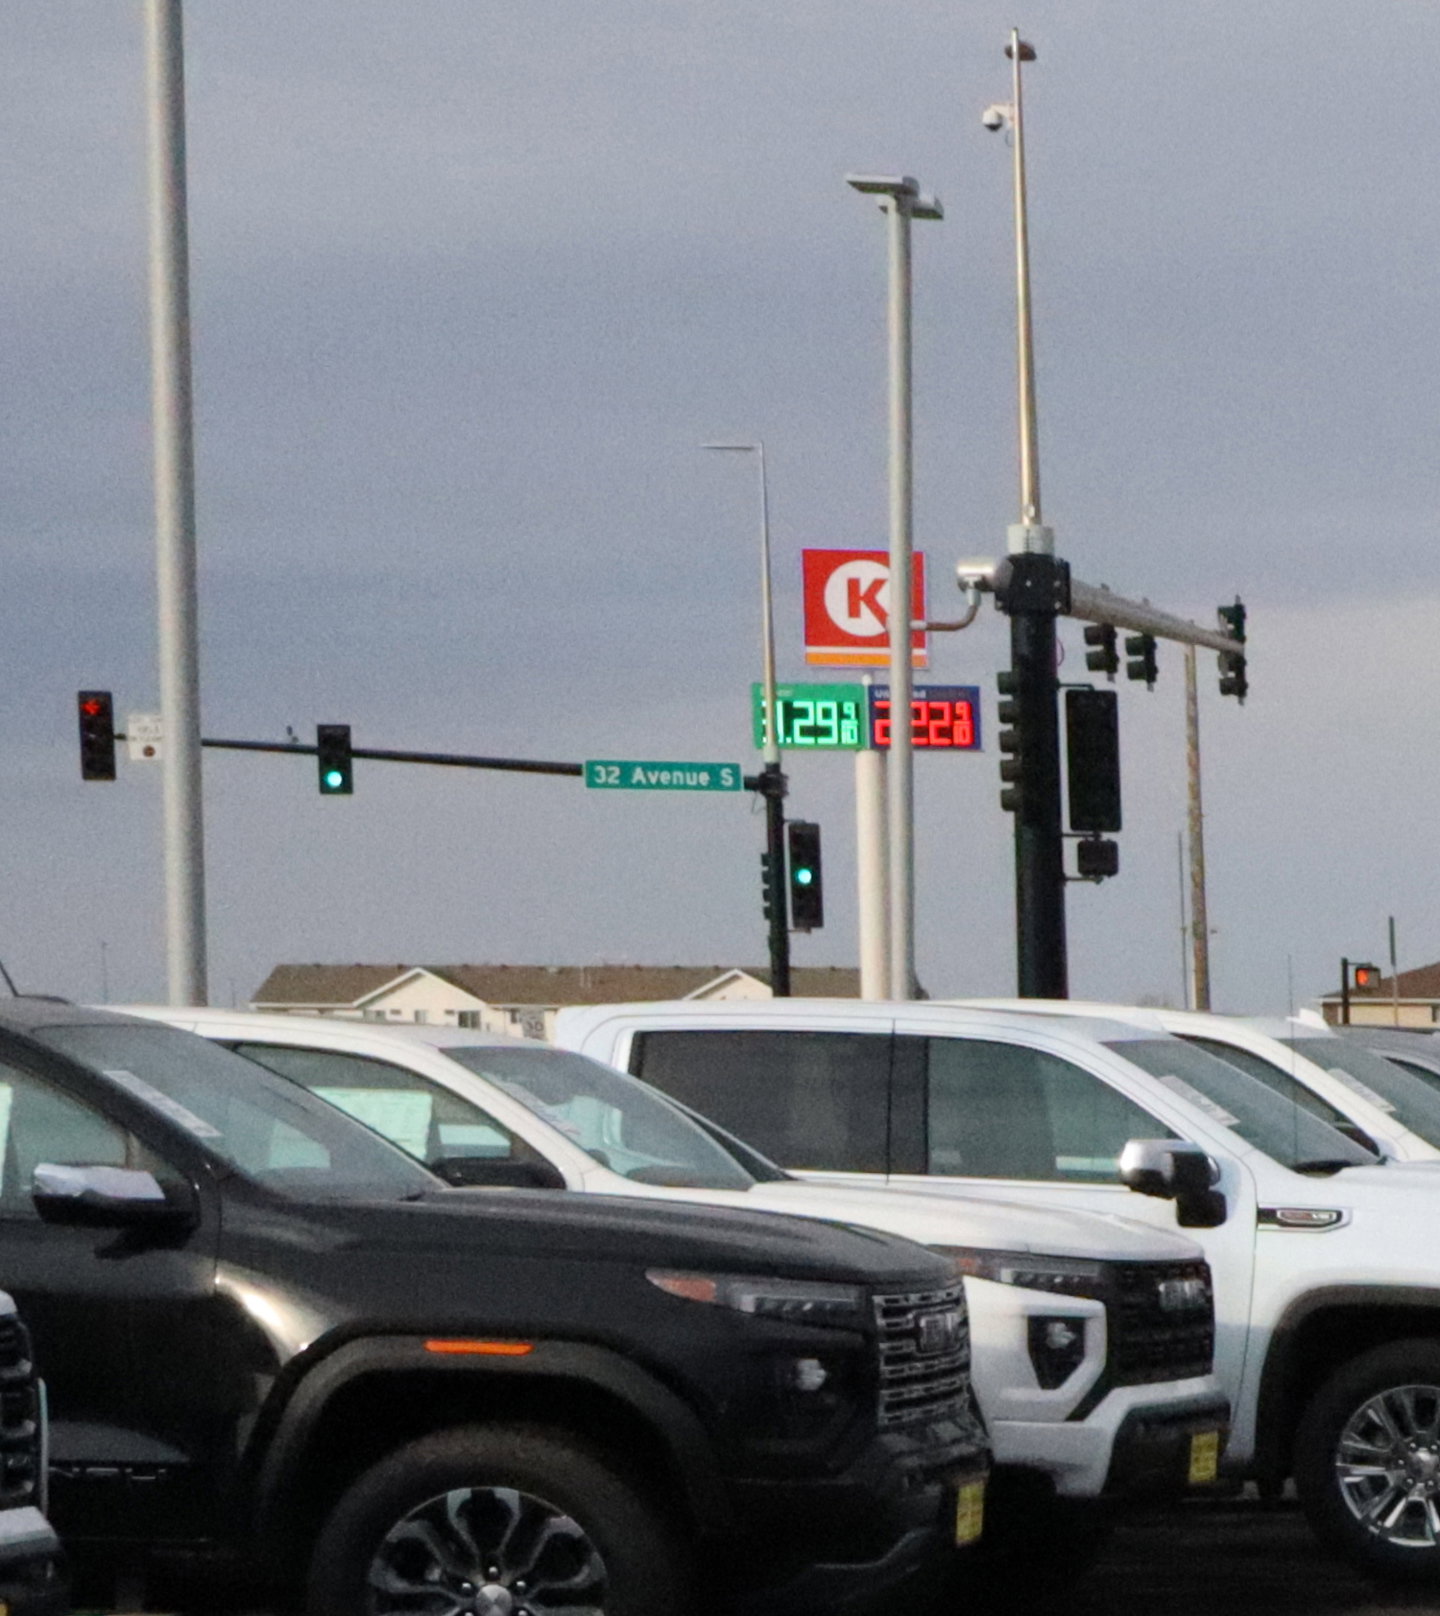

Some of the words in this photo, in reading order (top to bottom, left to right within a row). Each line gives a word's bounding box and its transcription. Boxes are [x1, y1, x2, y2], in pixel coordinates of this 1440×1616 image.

[847, 577, 890, 630] K
[594, 765, 620, 784] 32
[631, 767, 711, 786] Avenue
[720, 768, 734, 786] S
